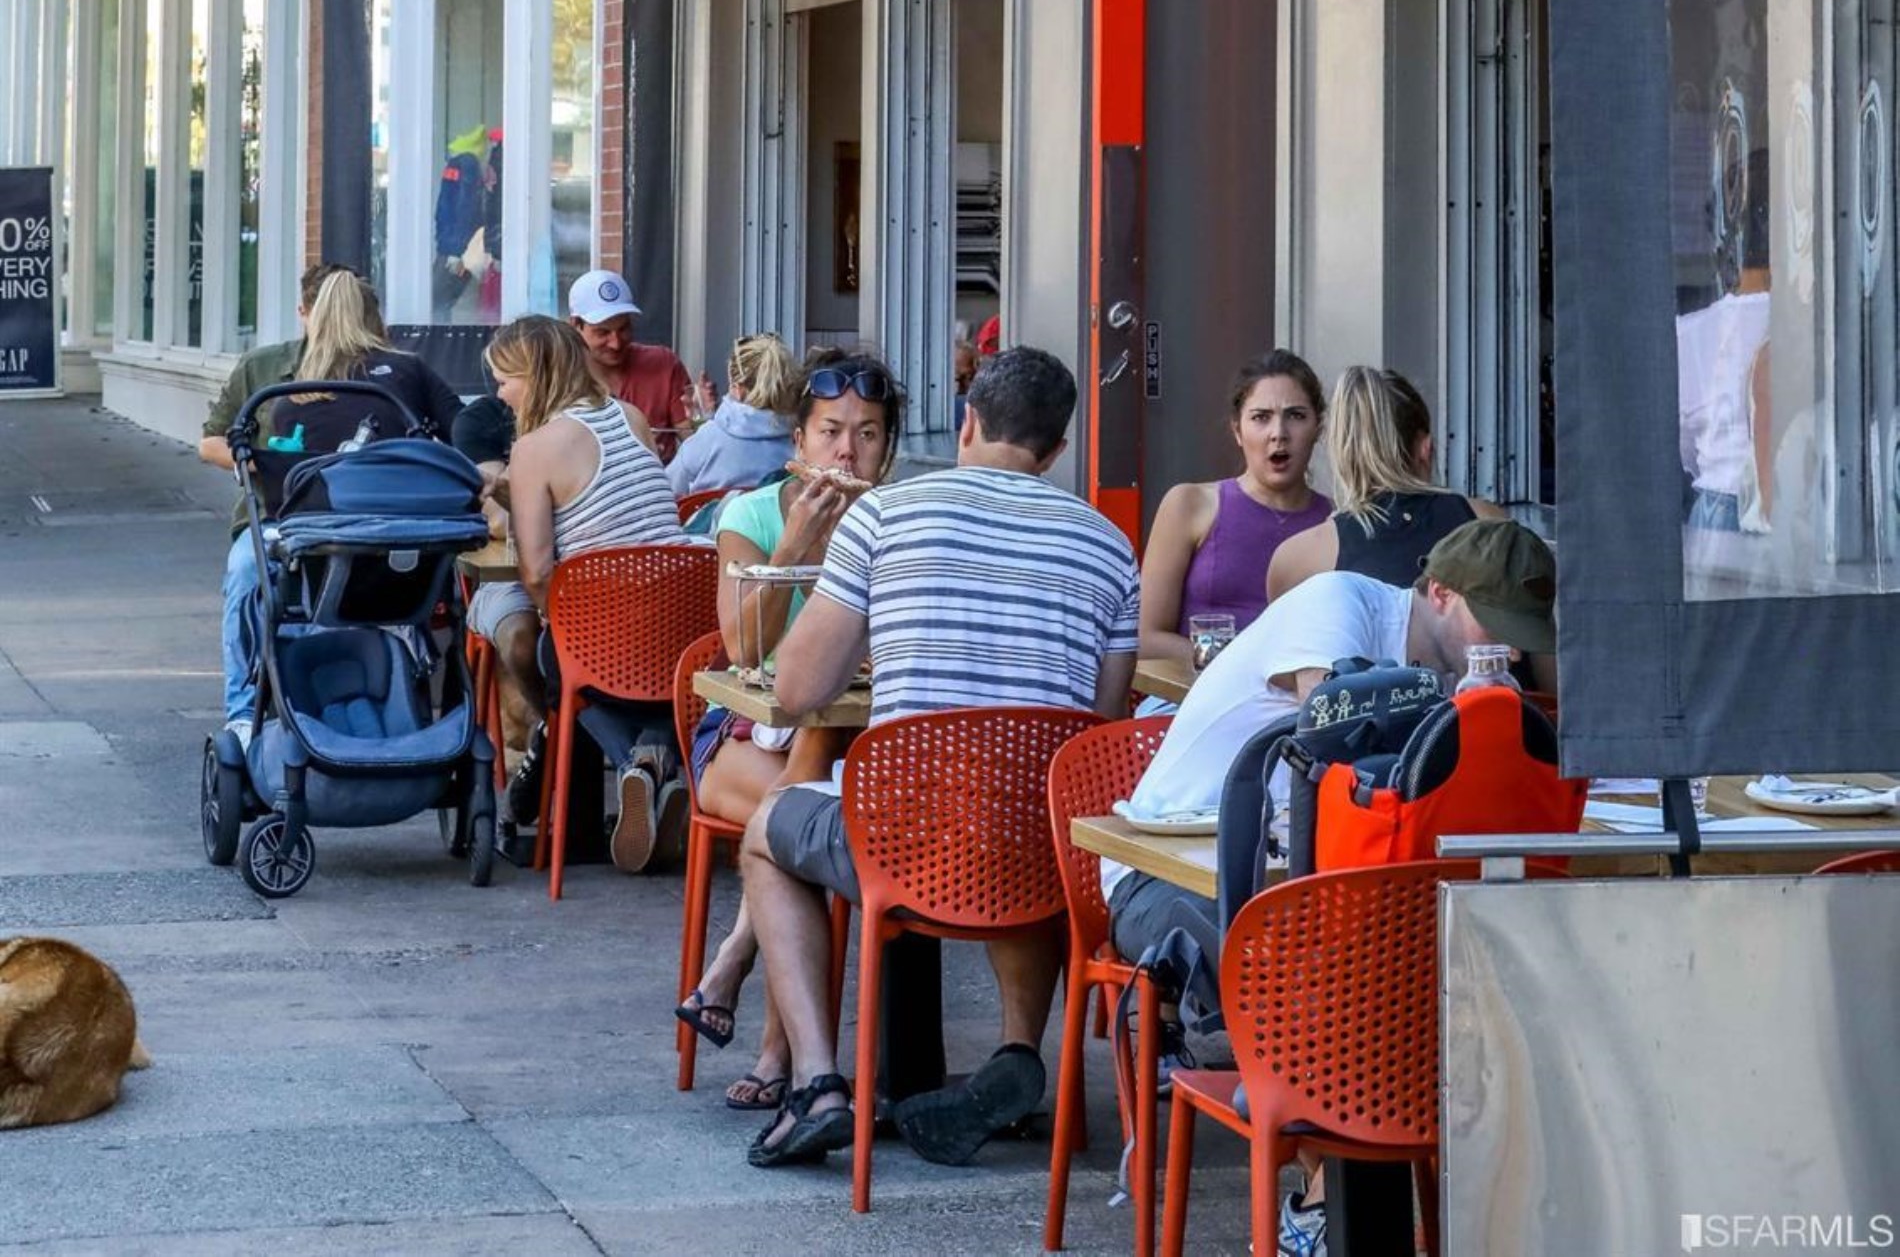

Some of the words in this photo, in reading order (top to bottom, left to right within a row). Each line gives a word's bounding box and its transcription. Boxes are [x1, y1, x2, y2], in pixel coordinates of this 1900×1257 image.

[25, 240, 50, 251] OFF
[0, 256, 50, 277] ERY
[1147, 324, 1158, 380] PUSH
